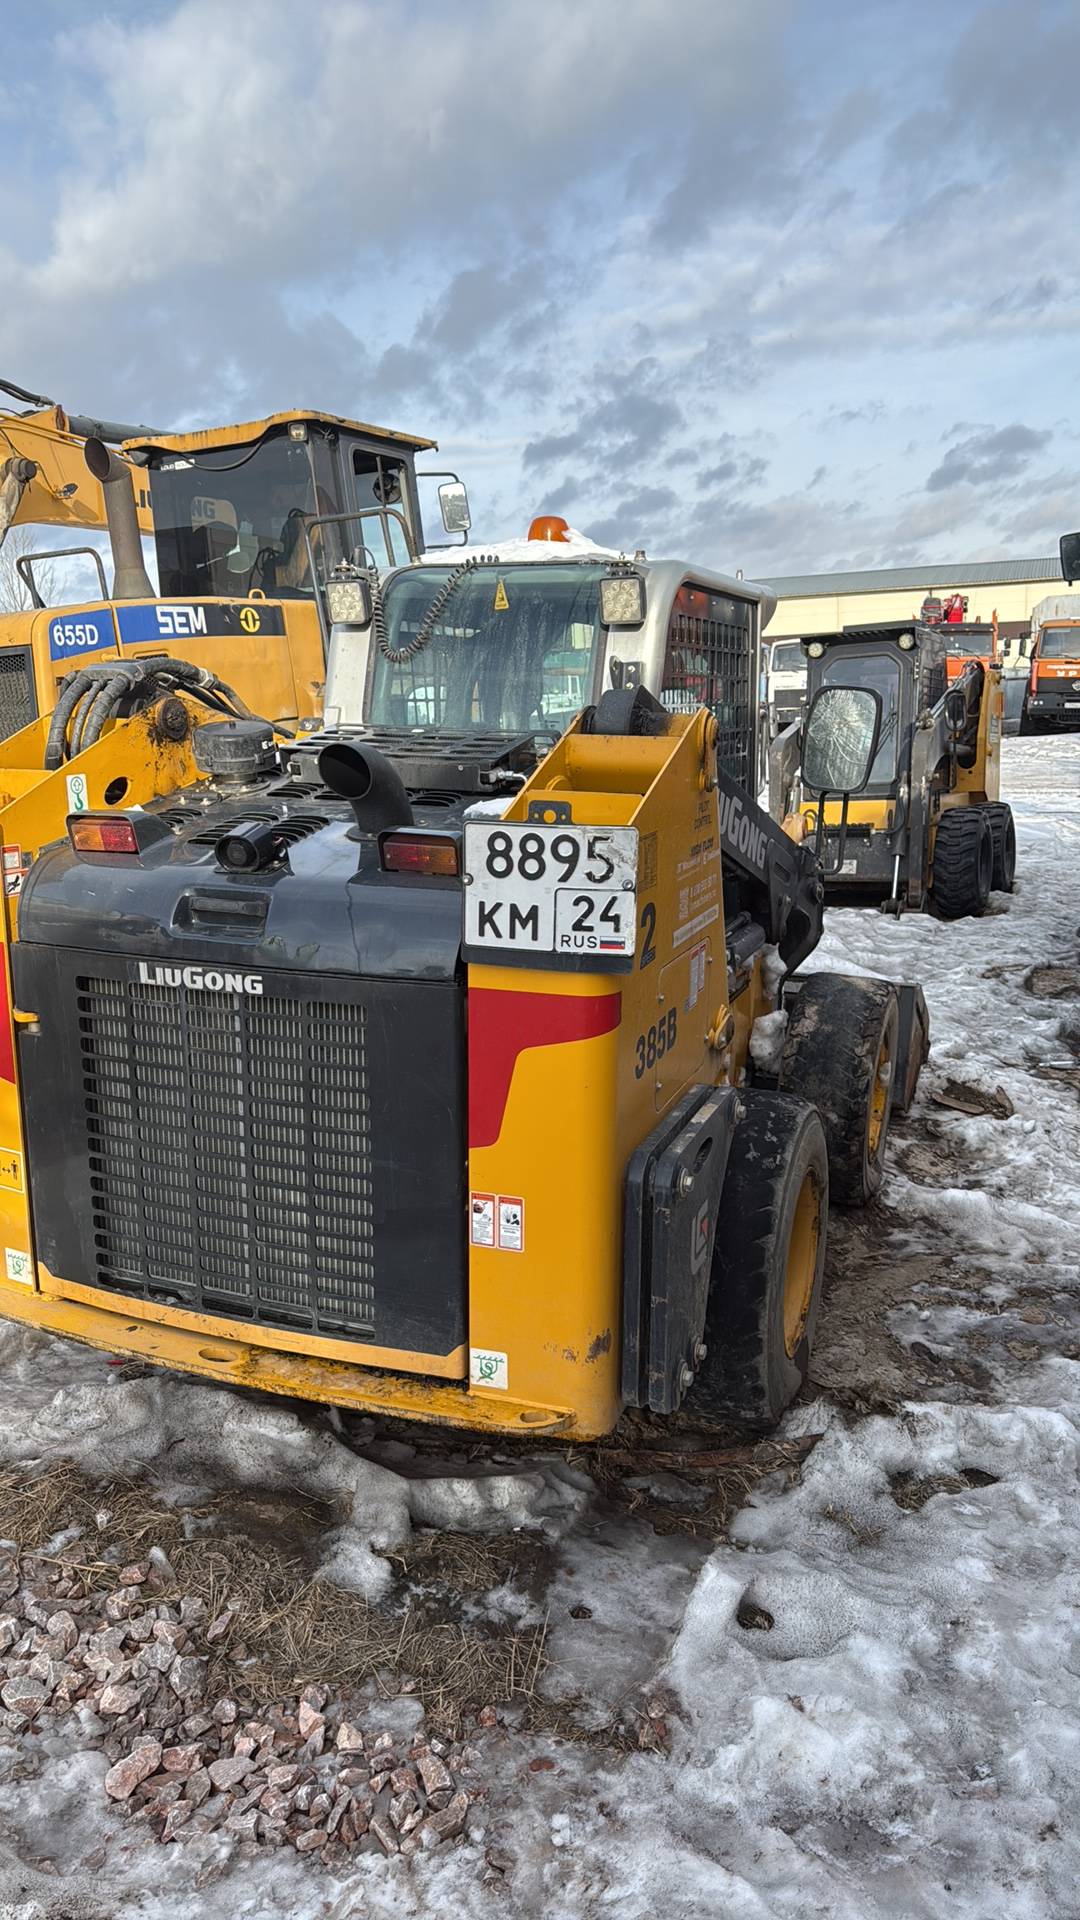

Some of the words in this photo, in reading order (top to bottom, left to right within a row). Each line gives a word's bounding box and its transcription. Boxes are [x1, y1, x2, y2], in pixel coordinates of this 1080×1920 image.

[53, 624, 99, 647] 655D
[156, 605, 208, 634] SEM
[486, 830, 615, 884] 8895
[572, 895, 621, 933] 24
[560, 934, 597, 949] RUS
[635, 1007, 677, 1079] 385B
